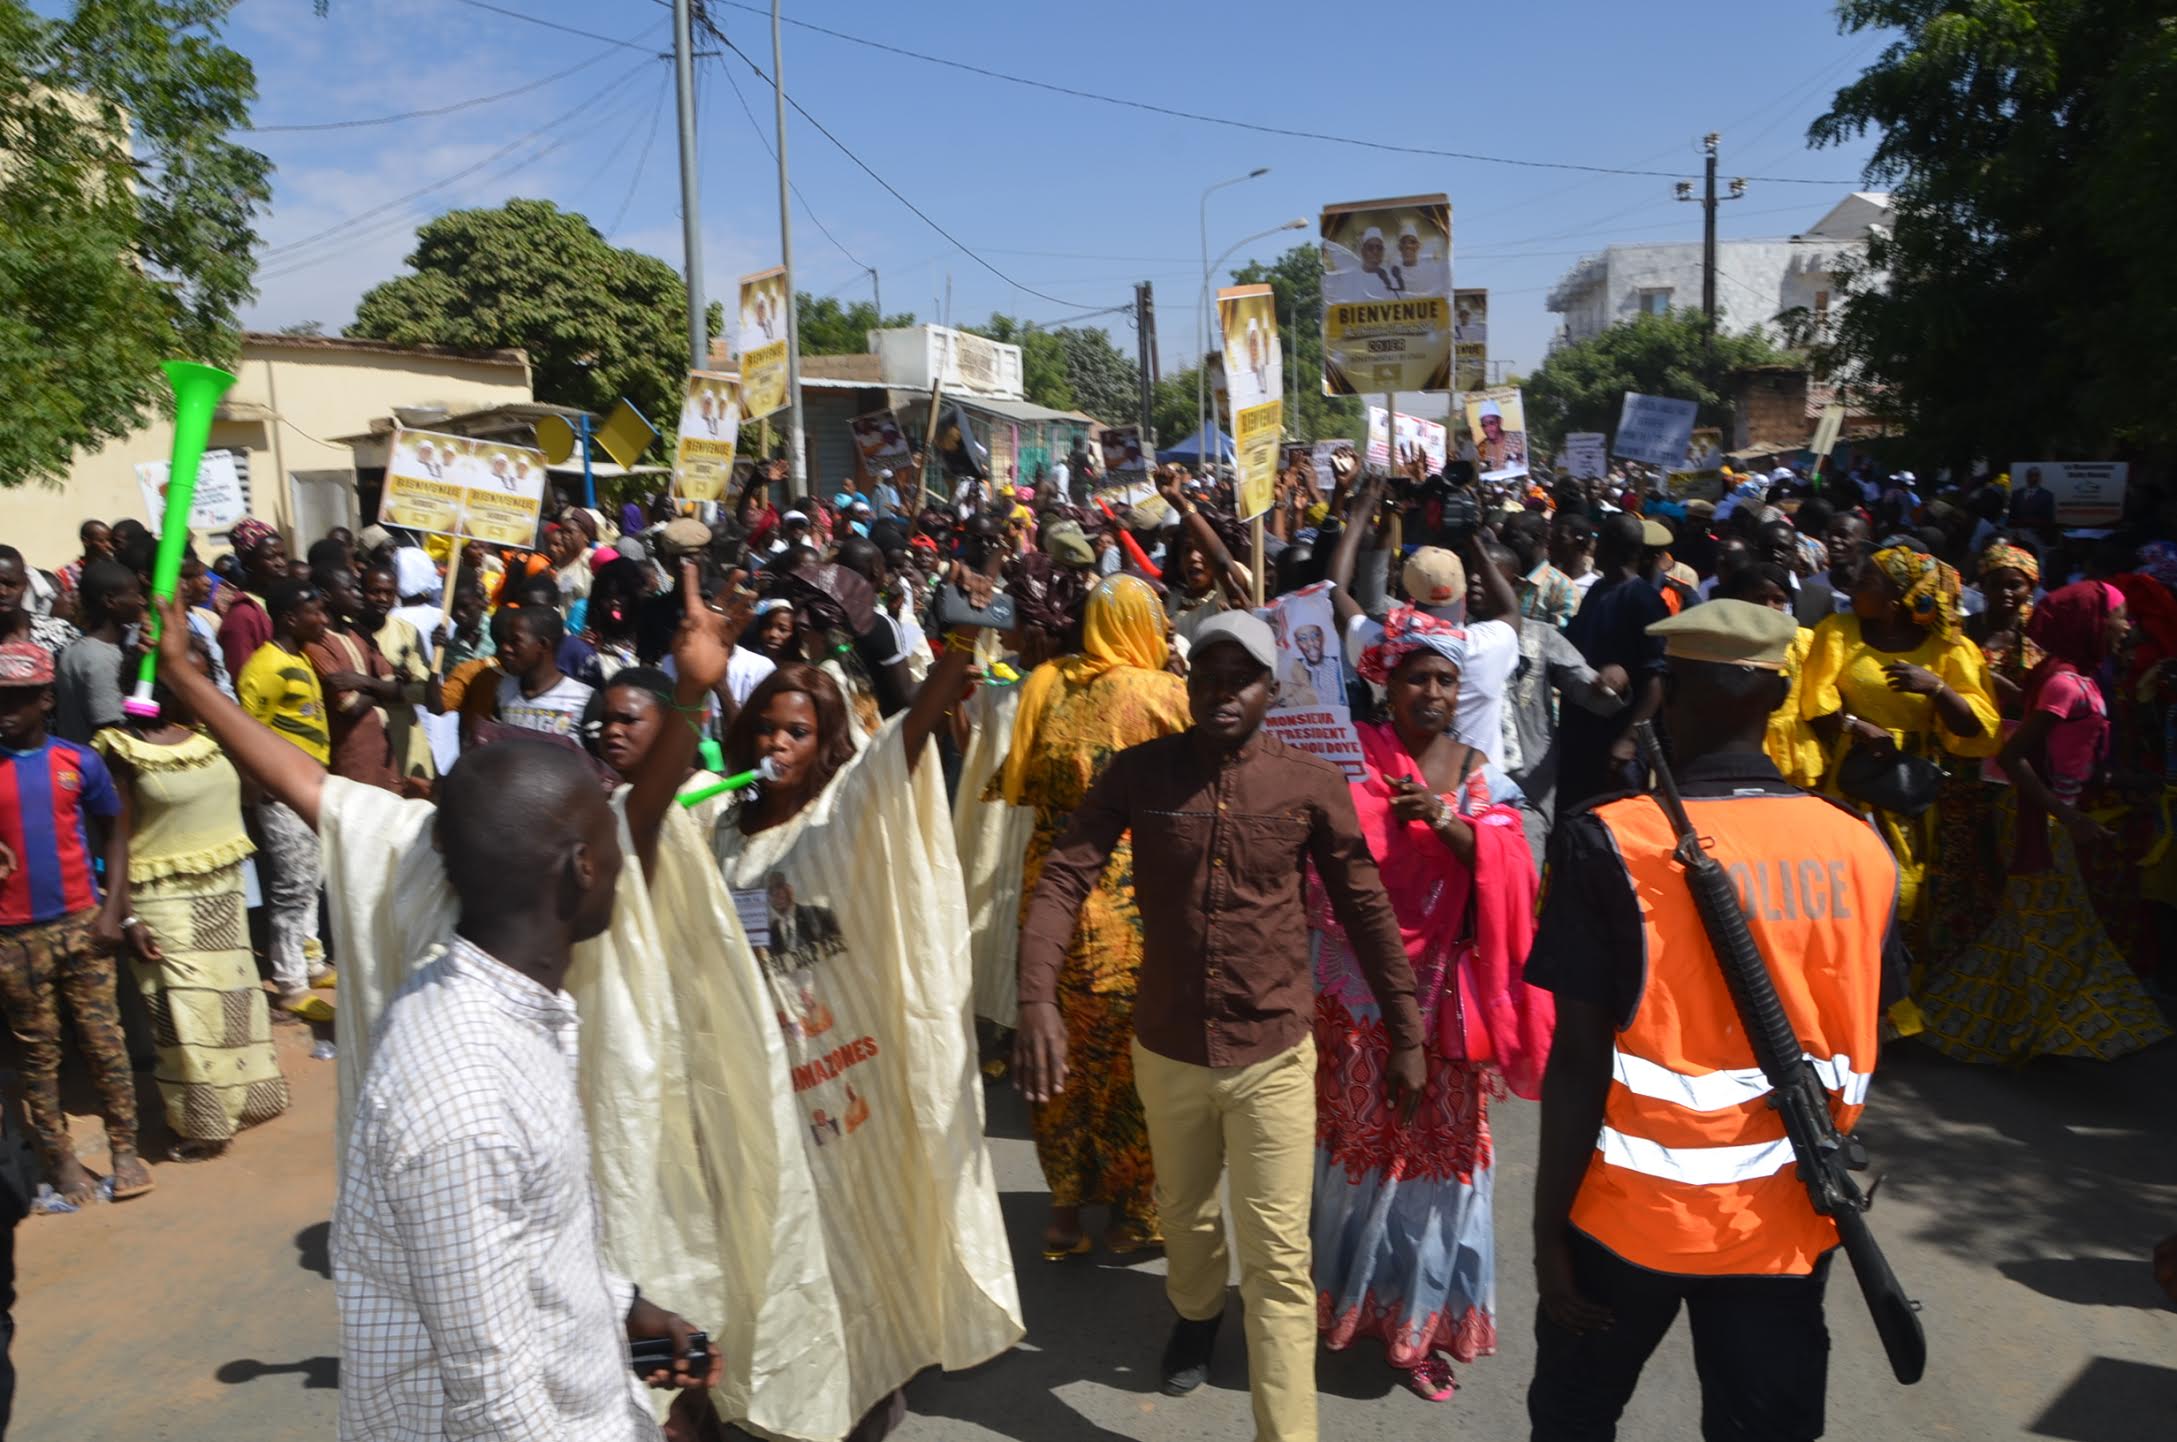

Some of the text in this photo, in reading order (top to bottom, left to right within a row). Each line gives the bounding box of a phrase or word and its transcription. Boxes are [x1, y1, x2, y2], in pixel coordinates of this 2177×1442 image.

[1339, 301, 1438, 324] BIENVENUE
[396, 476, 461, 499] BIENVENUE
[472, 489, 535, 511] BIENVENUE
[1264, 713, 1335, 727] MONSIEUR
[1727, 859, 1852, 921] OLICE
